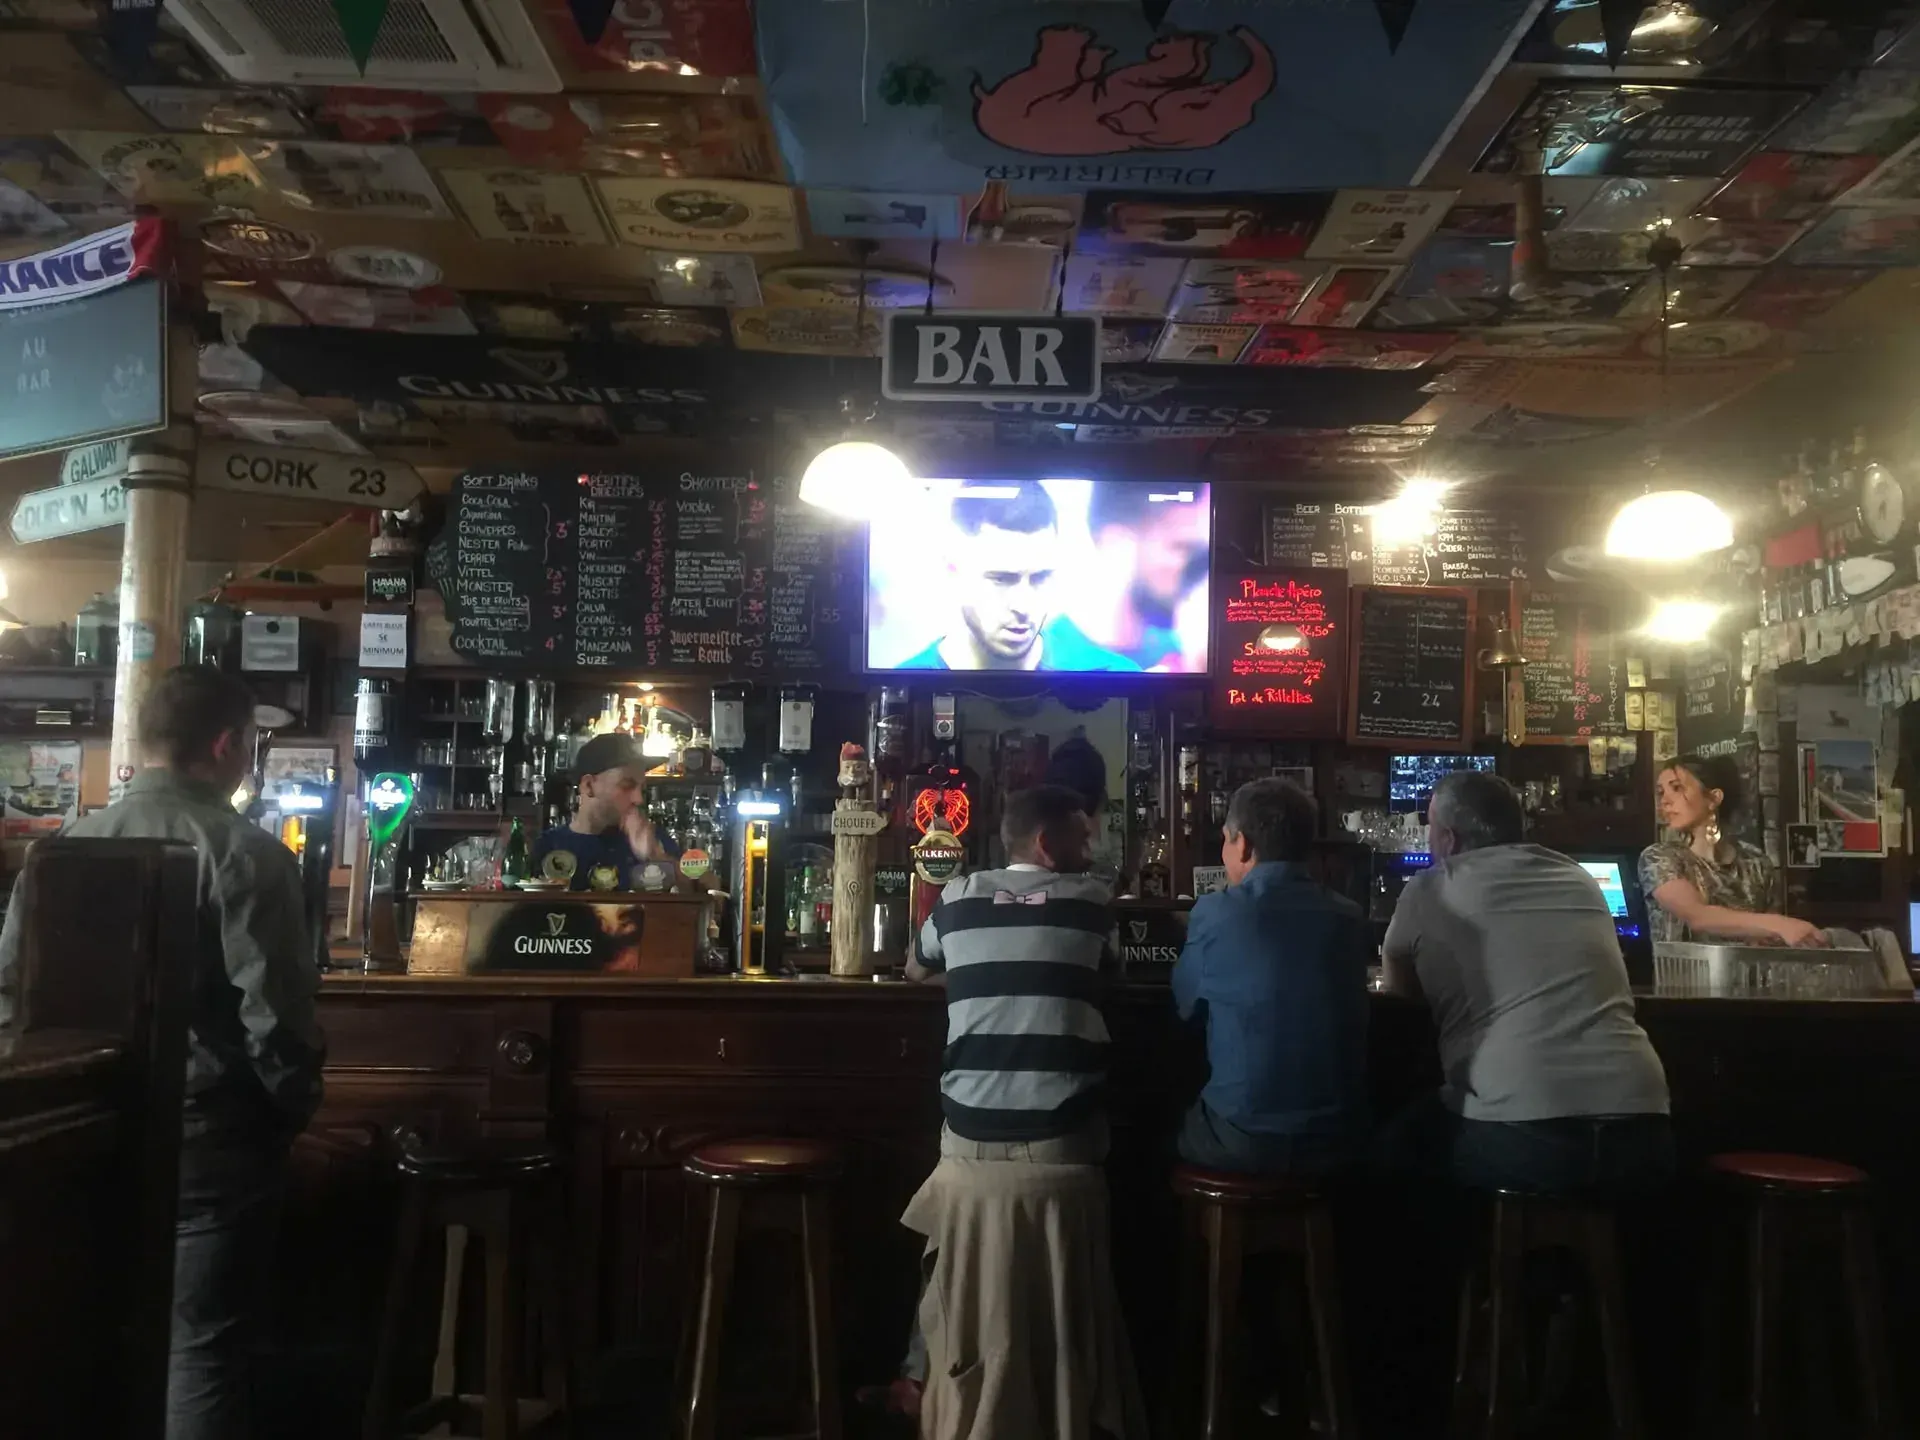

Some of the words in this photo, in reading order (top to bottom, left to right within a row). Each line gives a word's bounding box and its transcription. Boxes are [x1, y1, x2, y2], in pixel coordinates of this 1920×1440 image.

[914, 325, 1069, 387] BAR
[397, 374, 708, 404] GUINNESS
[70, 440, 118, 483] GALWAY
[226, 453, 320, 490] CORK
[348, 467, 387, 497] 23
[1296, 503, 1321, 514] BEER
[833, 817, 877, 829] CHOUFFE
[913, 848, 964, 859] KILKENNY
[514, 935, 593, 955] GUINNESS
[1120, 945, 1179, 963] INNESS
